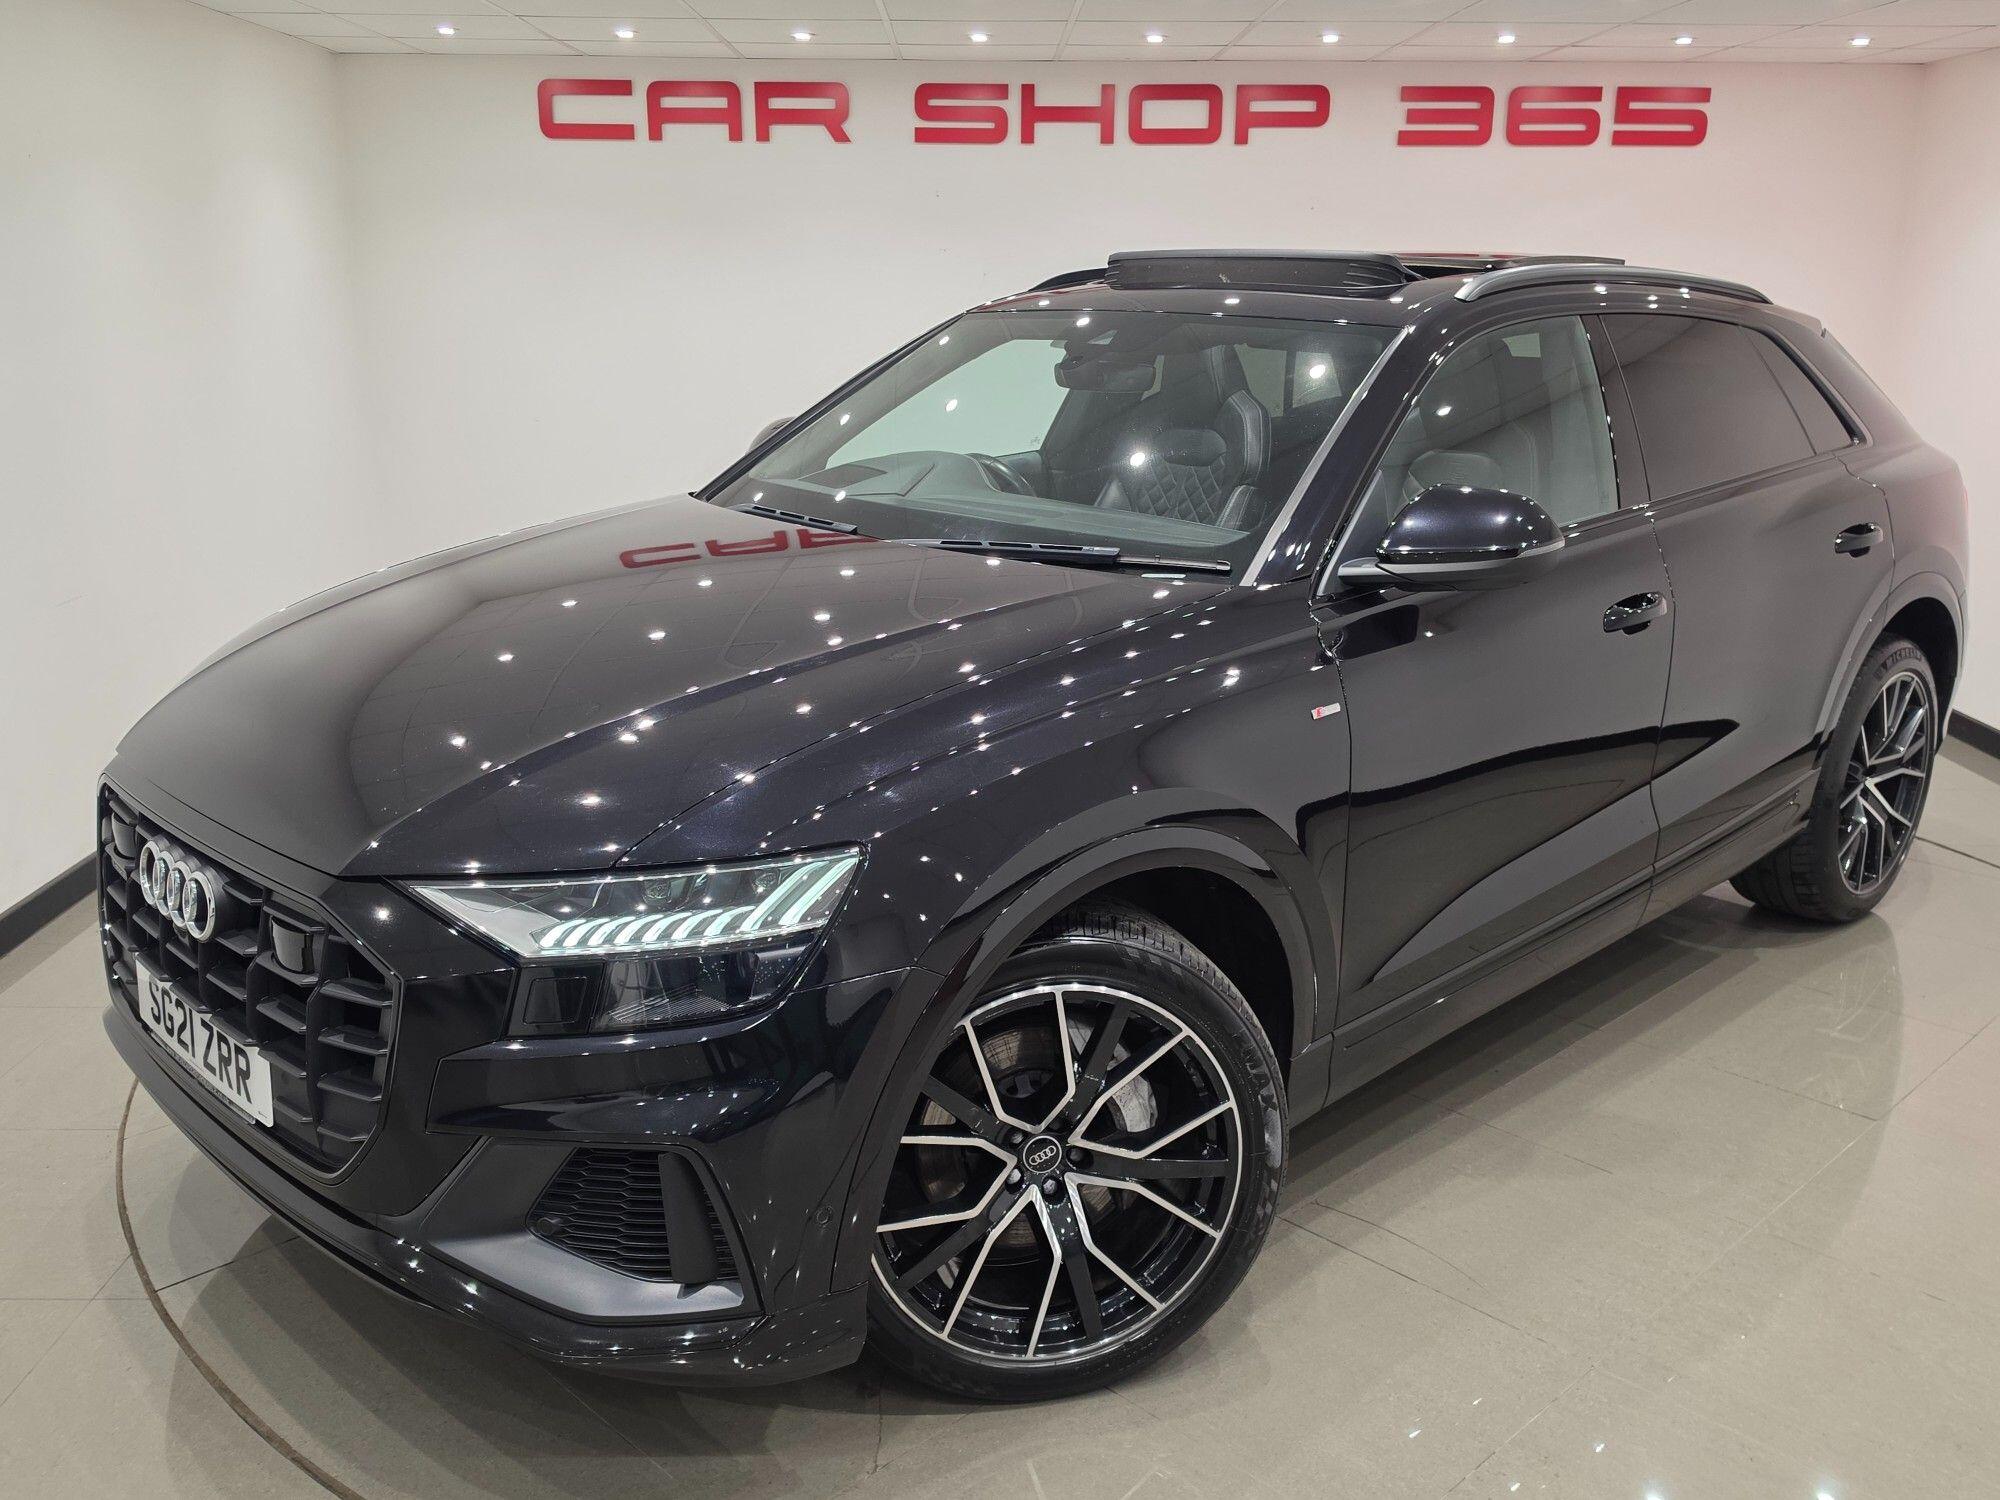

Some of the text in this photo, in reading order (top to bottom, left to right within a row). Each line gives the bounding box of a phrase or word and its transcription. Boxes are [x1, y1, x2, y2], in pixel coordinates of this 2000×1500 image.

[537, 78, 1712, 148] CAR SHOP 365
[149, 980, 253, 1104] SG21 ZRR
